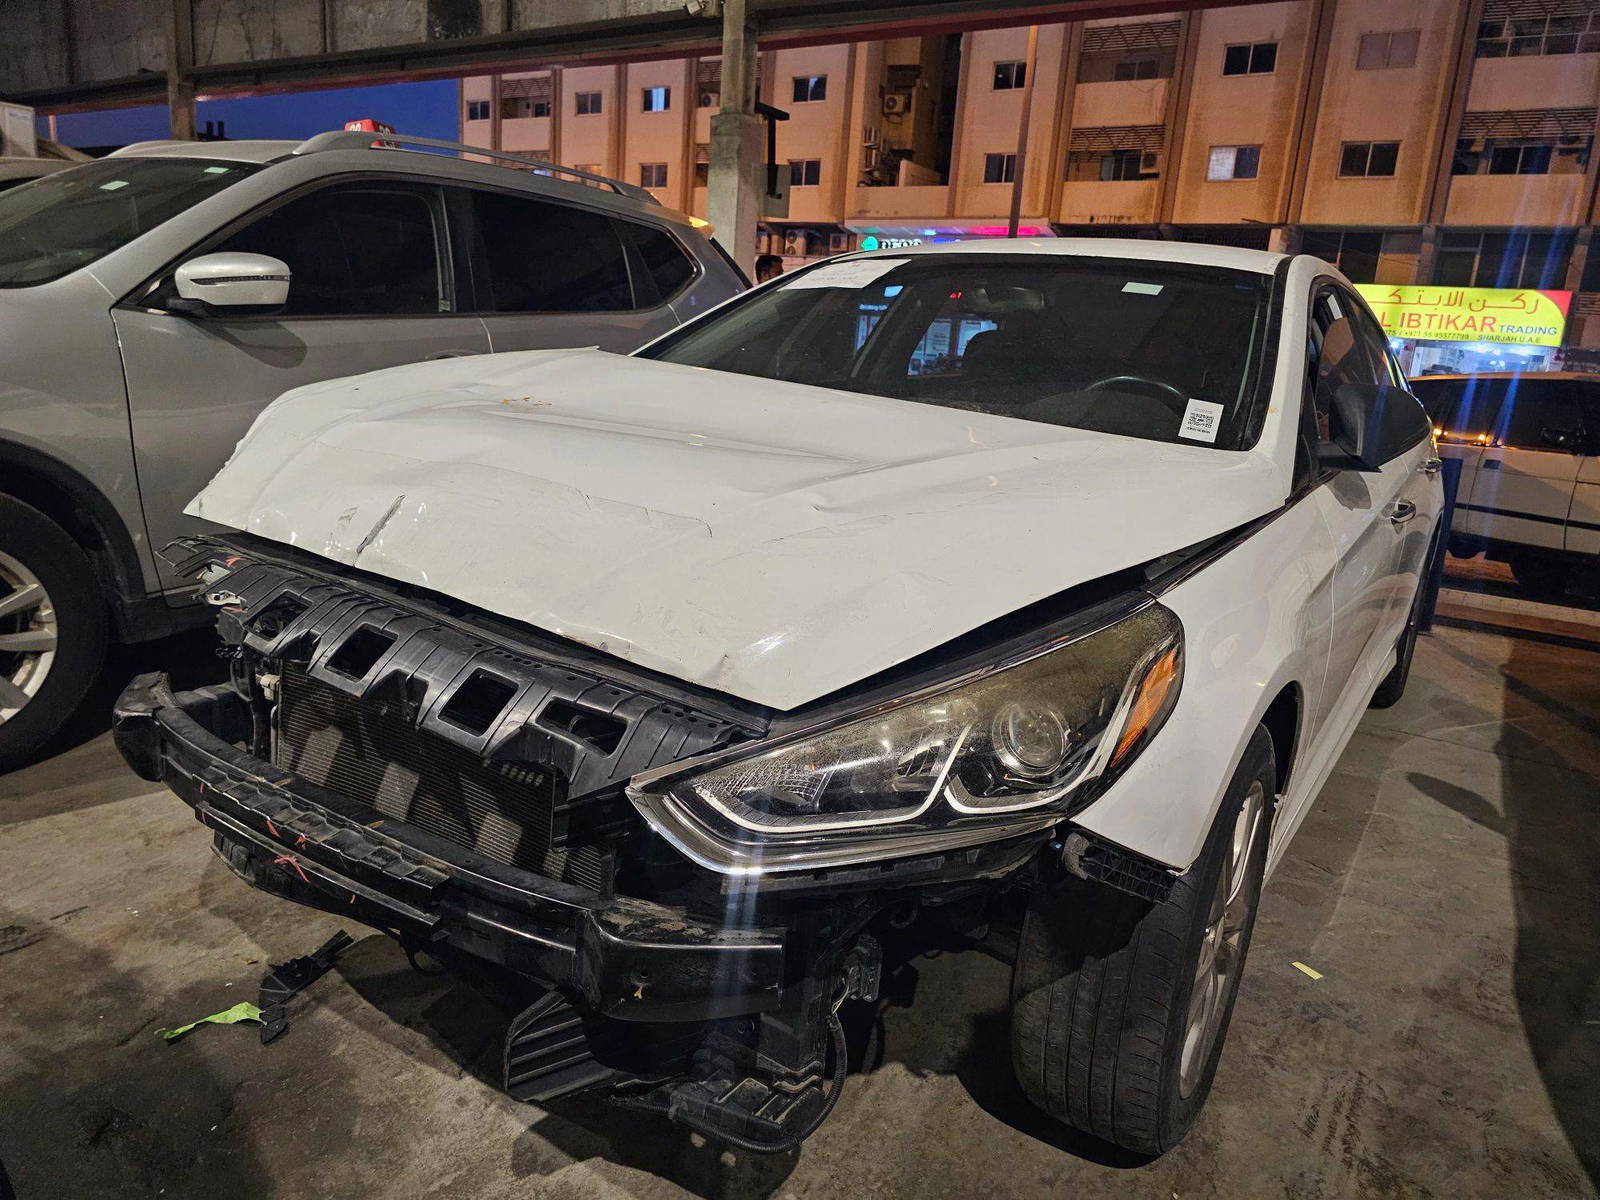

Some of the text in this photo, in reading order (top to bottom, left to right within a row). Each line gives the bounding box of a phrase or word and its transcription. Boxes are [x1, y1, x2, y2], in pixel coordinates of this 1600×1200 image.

[1367, 288, 1465, 311] الابتك
[1400, 312, 1497, 333] IBTIKAR
[1499, 324, 1557, 335] TRADING
[1478, 333, 1517, 342] SHARJAH
